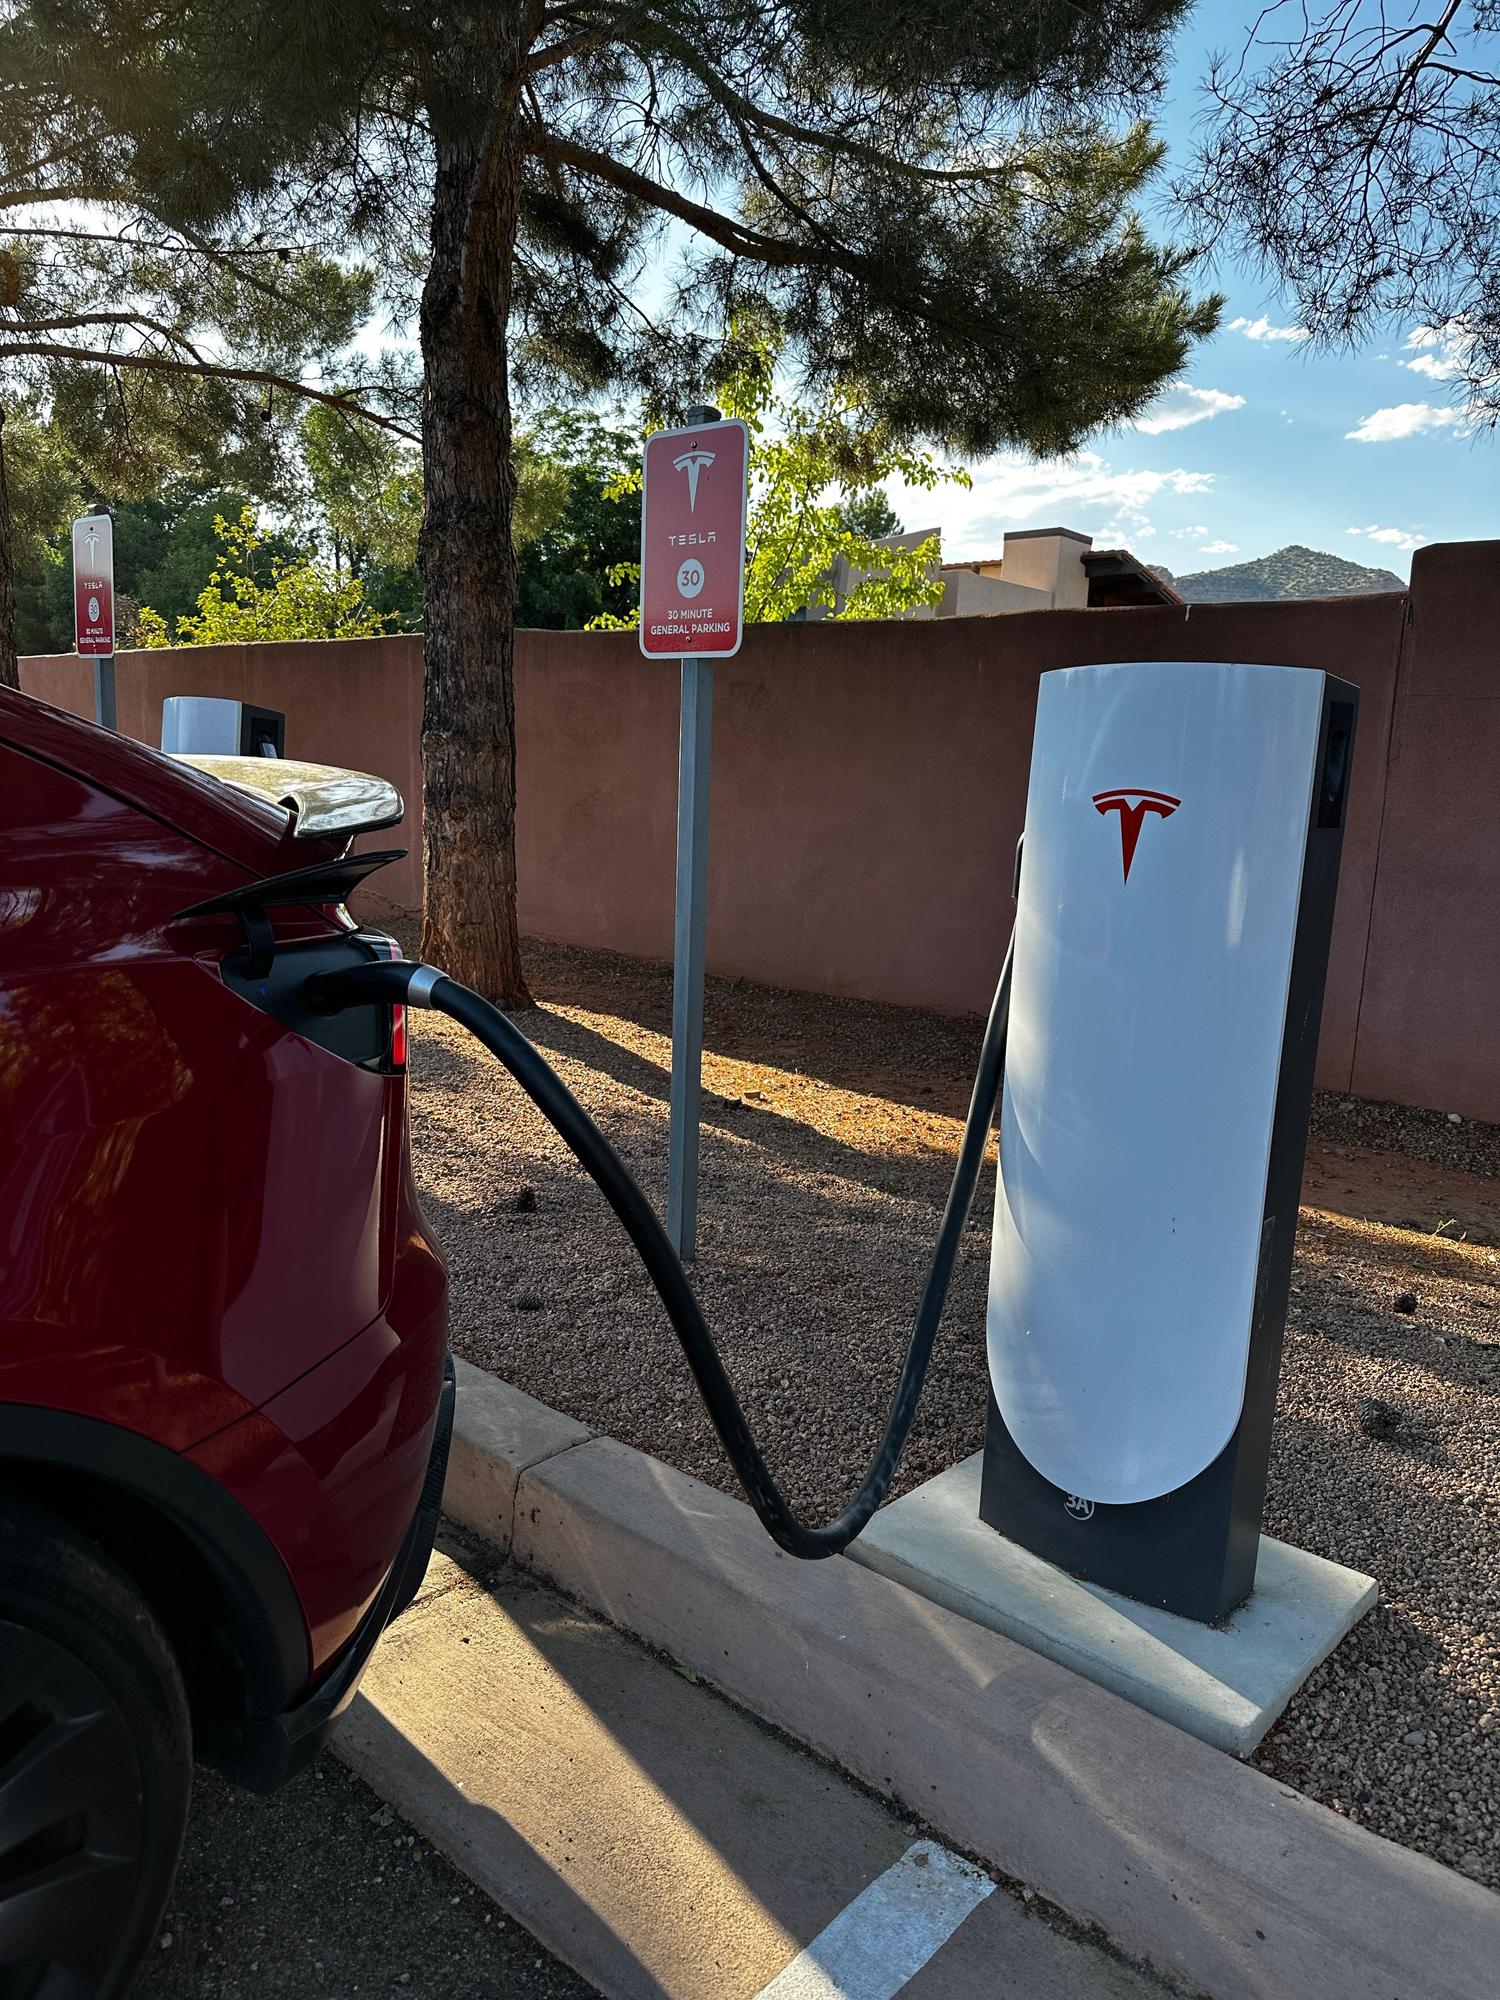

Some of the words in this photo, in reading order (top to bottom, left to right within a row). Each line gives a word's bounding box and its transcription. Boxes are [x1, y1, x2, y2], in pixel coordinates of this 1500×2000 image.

[668, 531, 716, 546] TESLA
[681, 570, 700, 587] 30
[84, 581, 103, 590] TESLA
[667, 610, 679, 620] 30
[680, 608, 713, 619] MINUTE
[650, 624, 690, 635] GENERAL
[691, 622, 731, 633] PARKING
